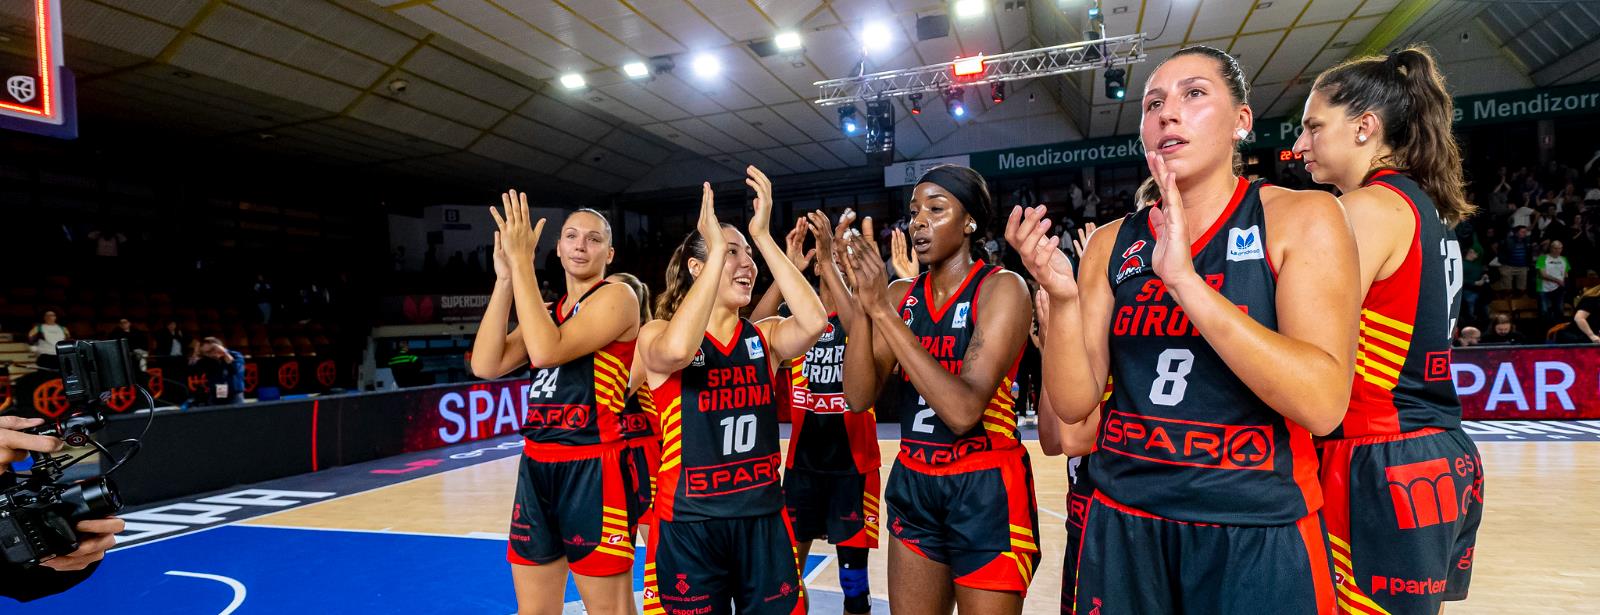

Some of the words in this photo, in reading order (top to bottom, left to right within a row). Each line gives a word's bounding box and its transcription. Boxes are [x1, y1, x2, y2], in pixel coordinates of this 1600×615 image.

[441, 295, 491, 308] SUPERCOP
[529, 366, 560, 399] 24
[707, 365, 758, 388] SPAR
[1149, 348, 1195, 406] 8
[698, 384, 771, 412] GIRONA
[912, 395, 937, 434] 2
[720, 414, 757, 456] 10
[1106, 418, 1221, 458] SPAR
[690, 461, 773, 491] SPAR
